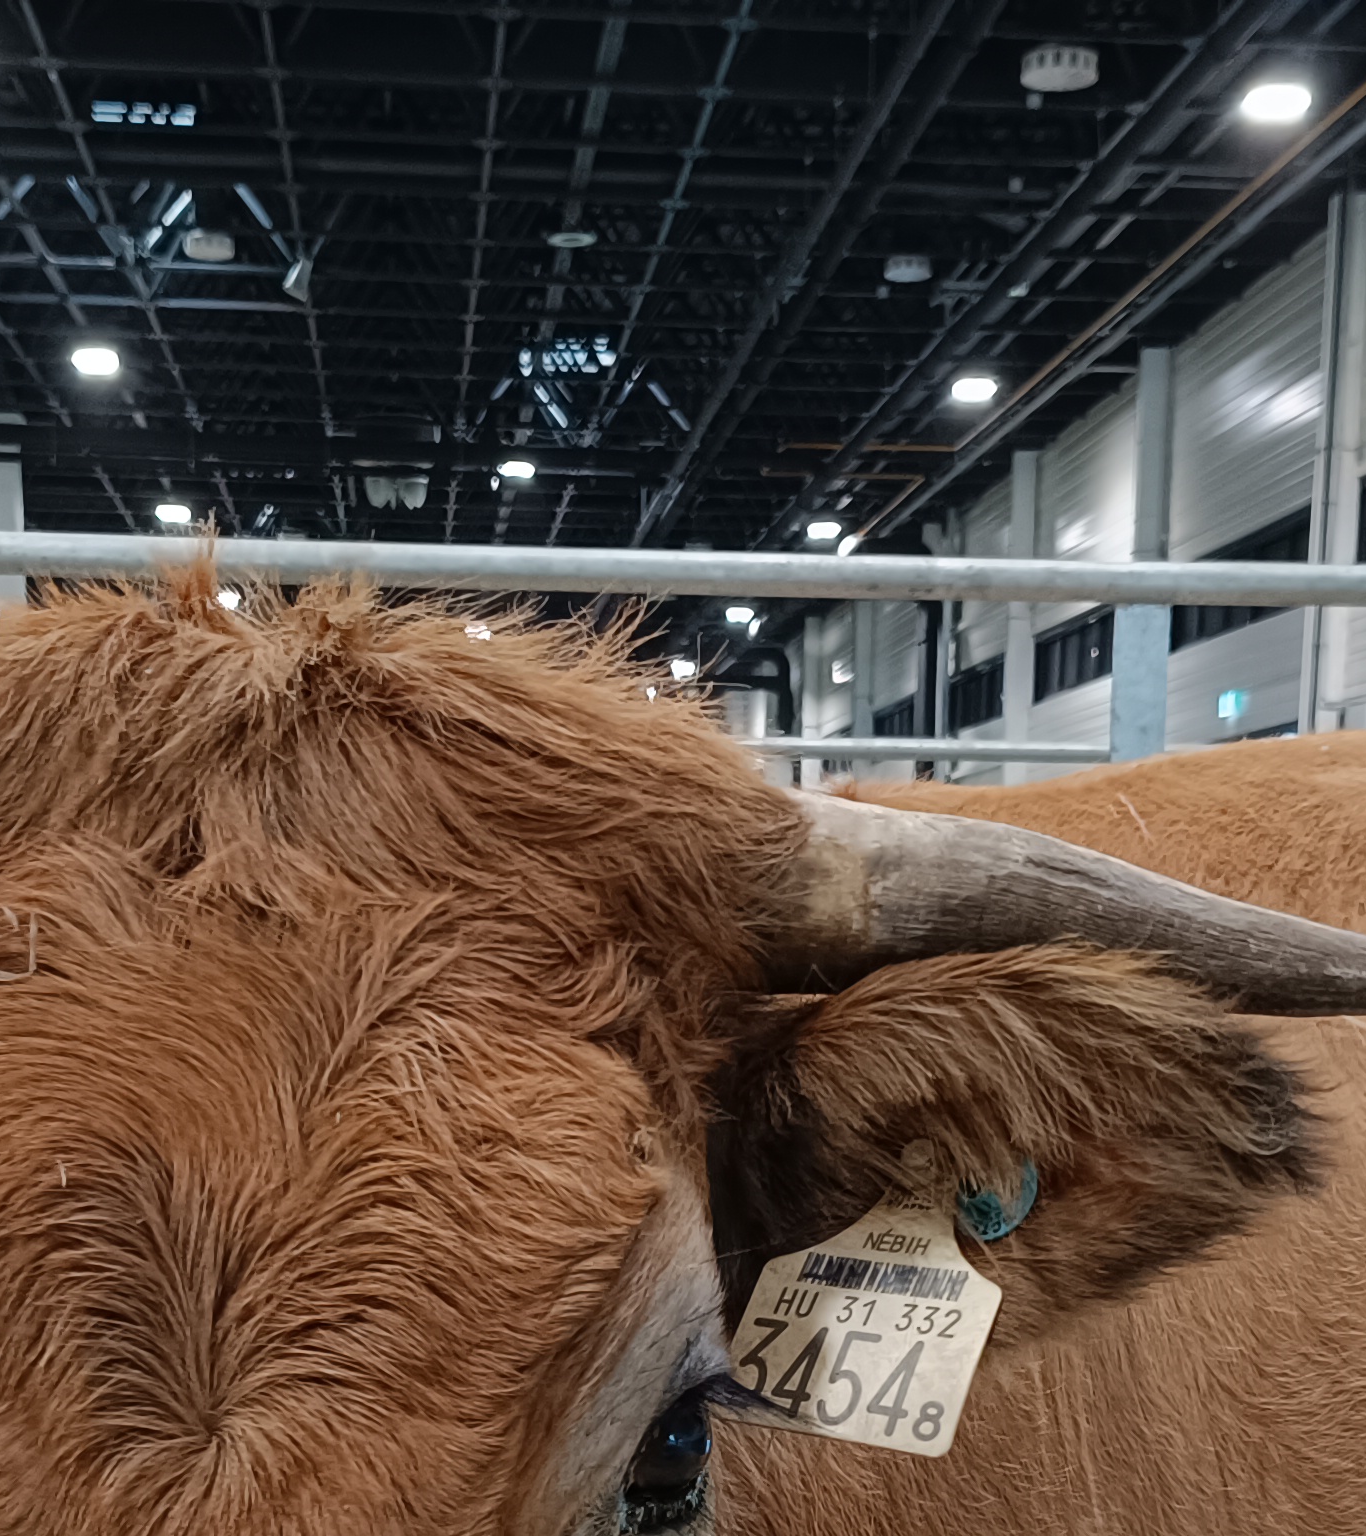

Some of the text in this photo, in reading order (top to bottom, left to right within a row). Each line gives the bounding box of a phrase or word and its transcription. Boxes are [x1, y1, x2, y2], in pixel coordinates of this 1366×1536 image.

[862, 1228, 932, 1255] NÉBIH
[773, 1287, 962, 1339] HU 31 332
